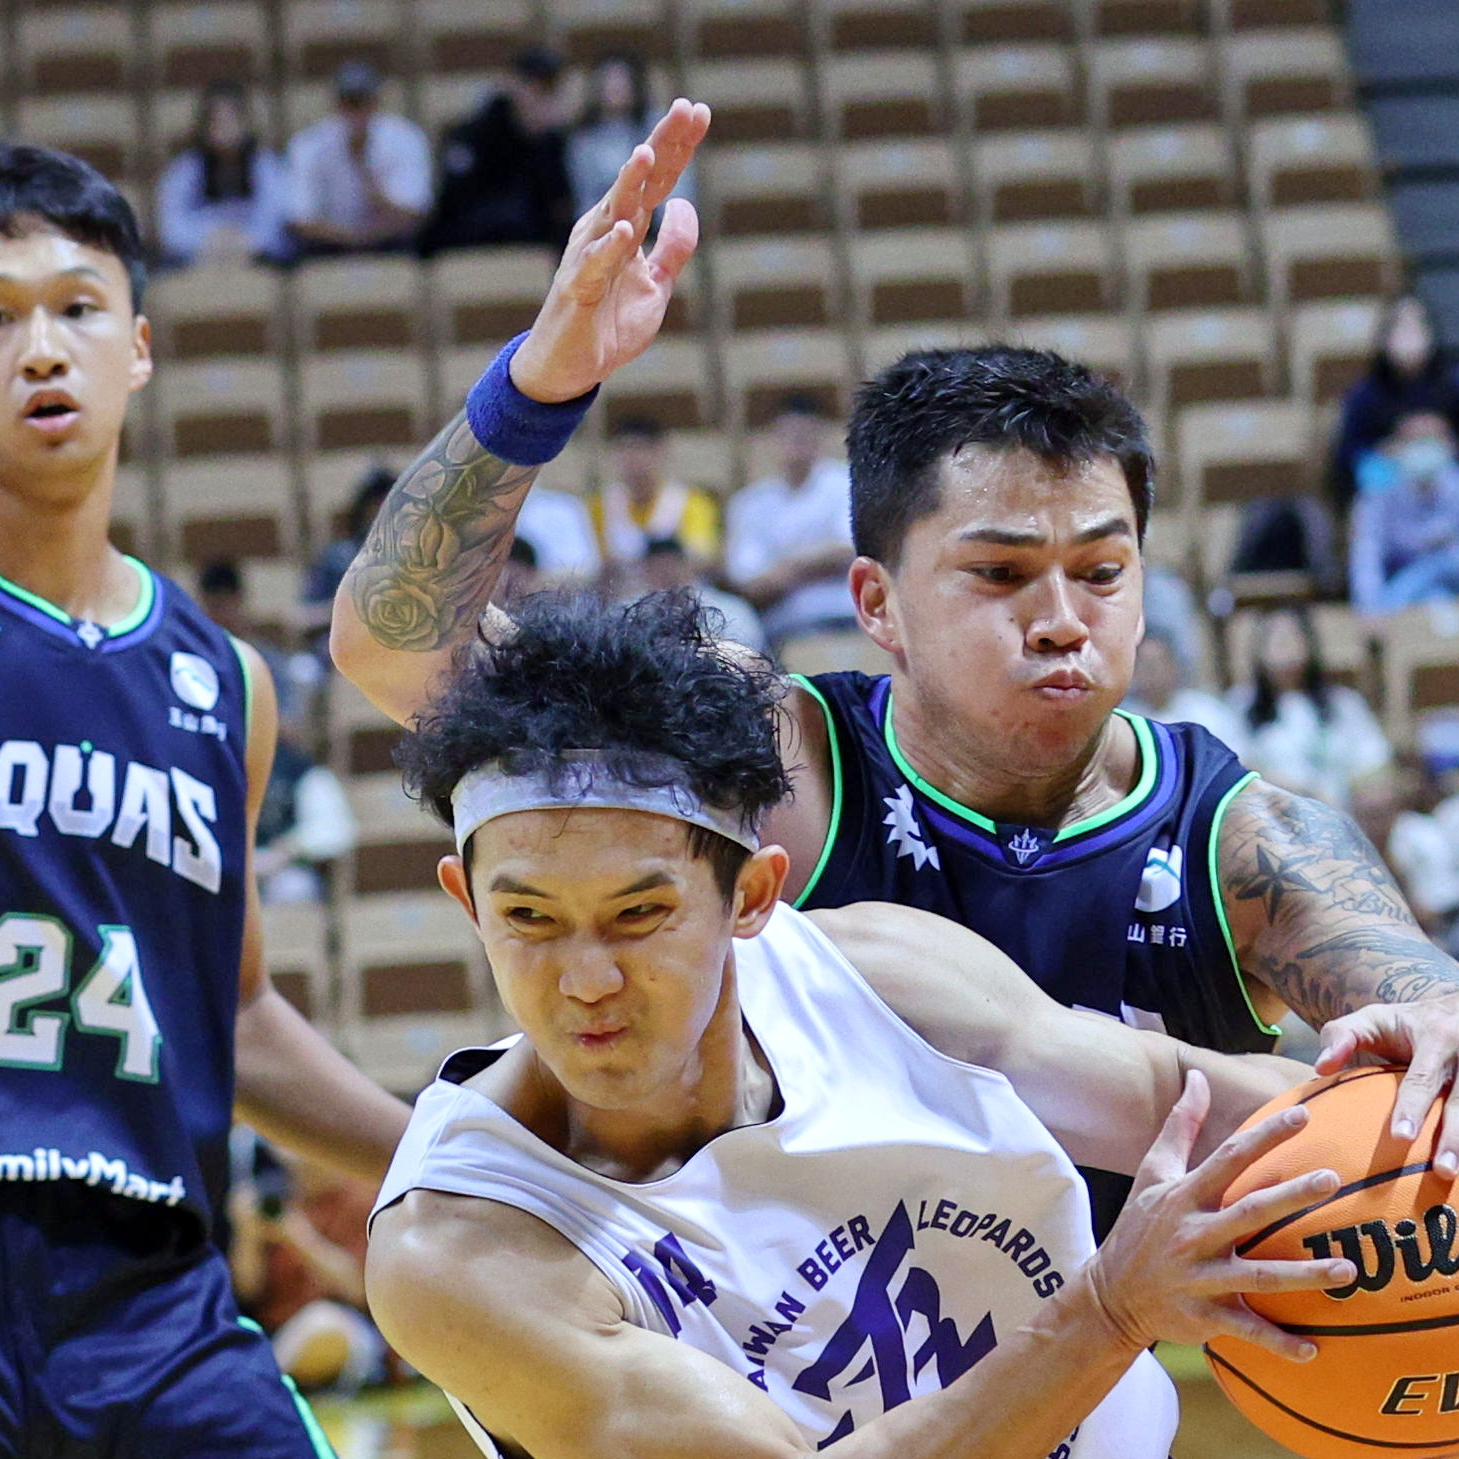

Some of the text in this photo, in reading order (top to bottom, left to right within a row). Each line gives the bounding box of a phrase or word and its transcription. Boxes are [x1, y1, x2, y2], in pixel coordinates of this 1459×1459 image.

[1126, 923, 1187, 947] 山銀行
[621, 1231, 718, 1340] 14
[742, 1199, 1065, 1392] AIWAN BEER LEOPARDS
[1400, 1287, 1451, 1303] INDOOR
